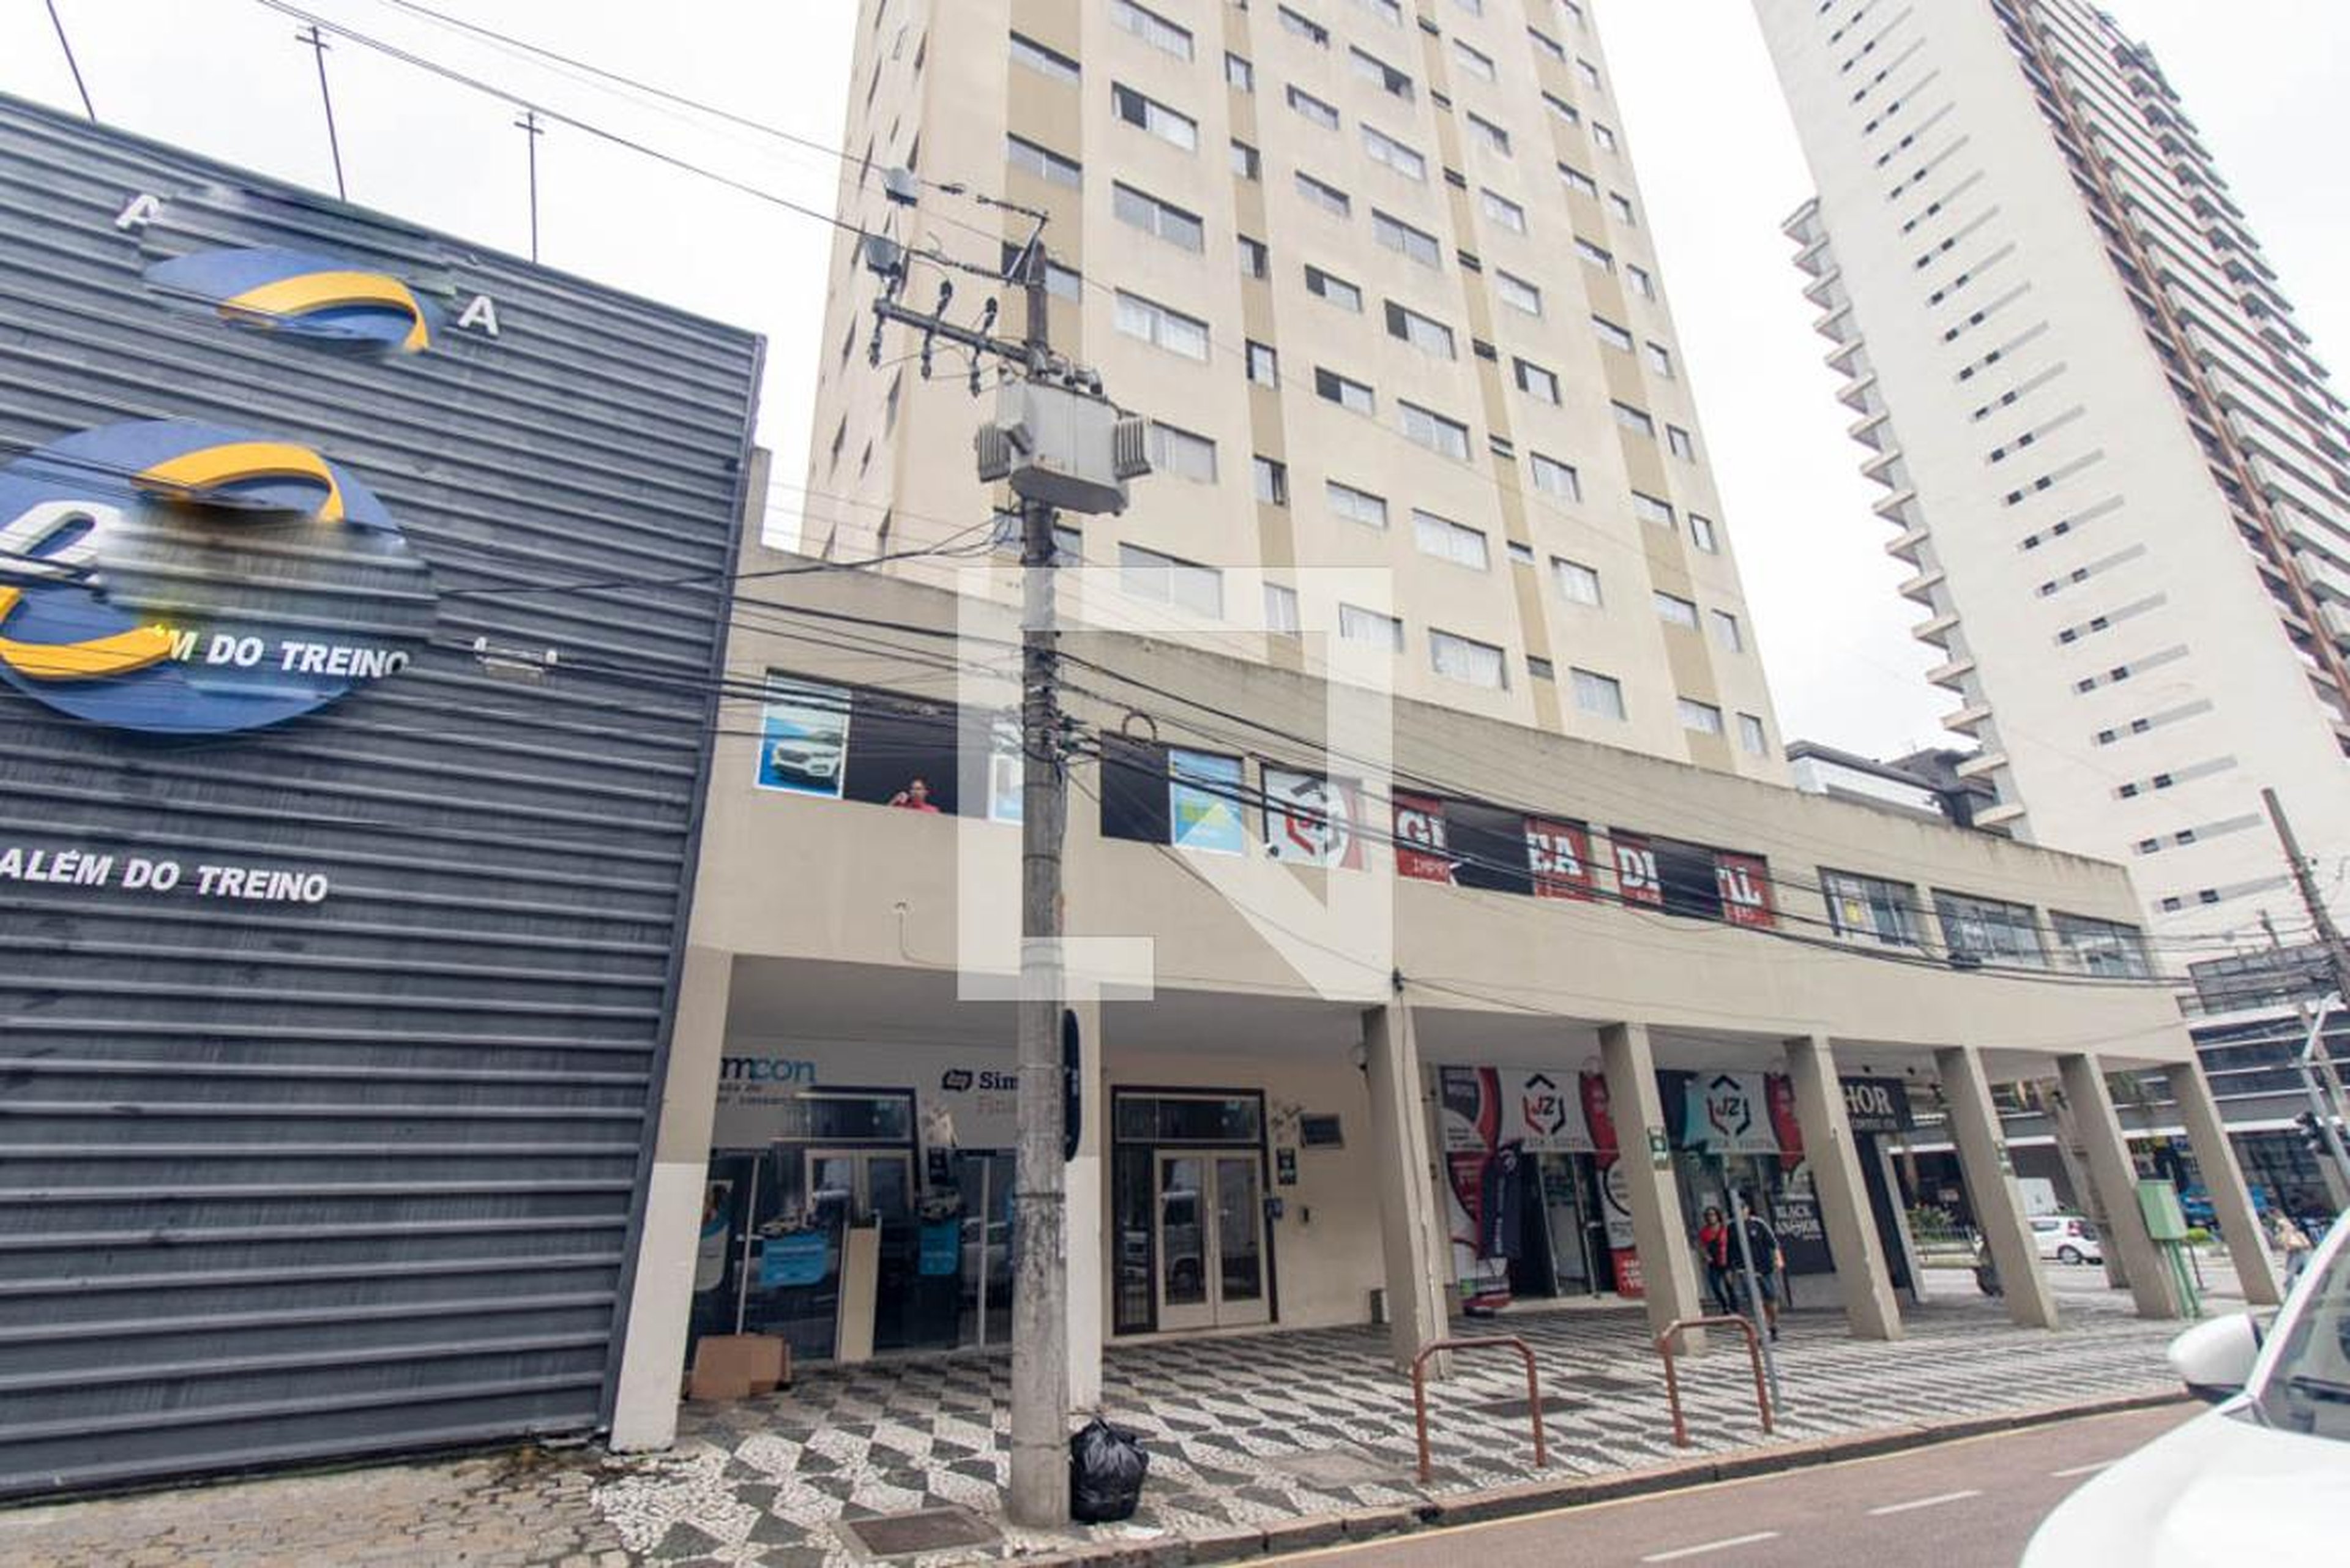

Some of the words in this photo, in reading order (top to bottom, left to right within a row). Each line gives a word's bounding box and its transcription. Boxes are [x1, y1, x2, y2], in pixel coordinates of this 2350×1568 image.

[458, 295, 499, 336] A
[207, 634, 265, 667] DO
[280, 641, 409, 678] TREINO
[0, 848, 113, 886] ALÉM
[122, 859, 180, 891] DO
[196, 865, 329, 902] TREINO
[720, 1057, 817, 1085] mcon
[979, 1071, 1018, 1091] Sim
[1844, 1084, 1897, 1116] HOR
